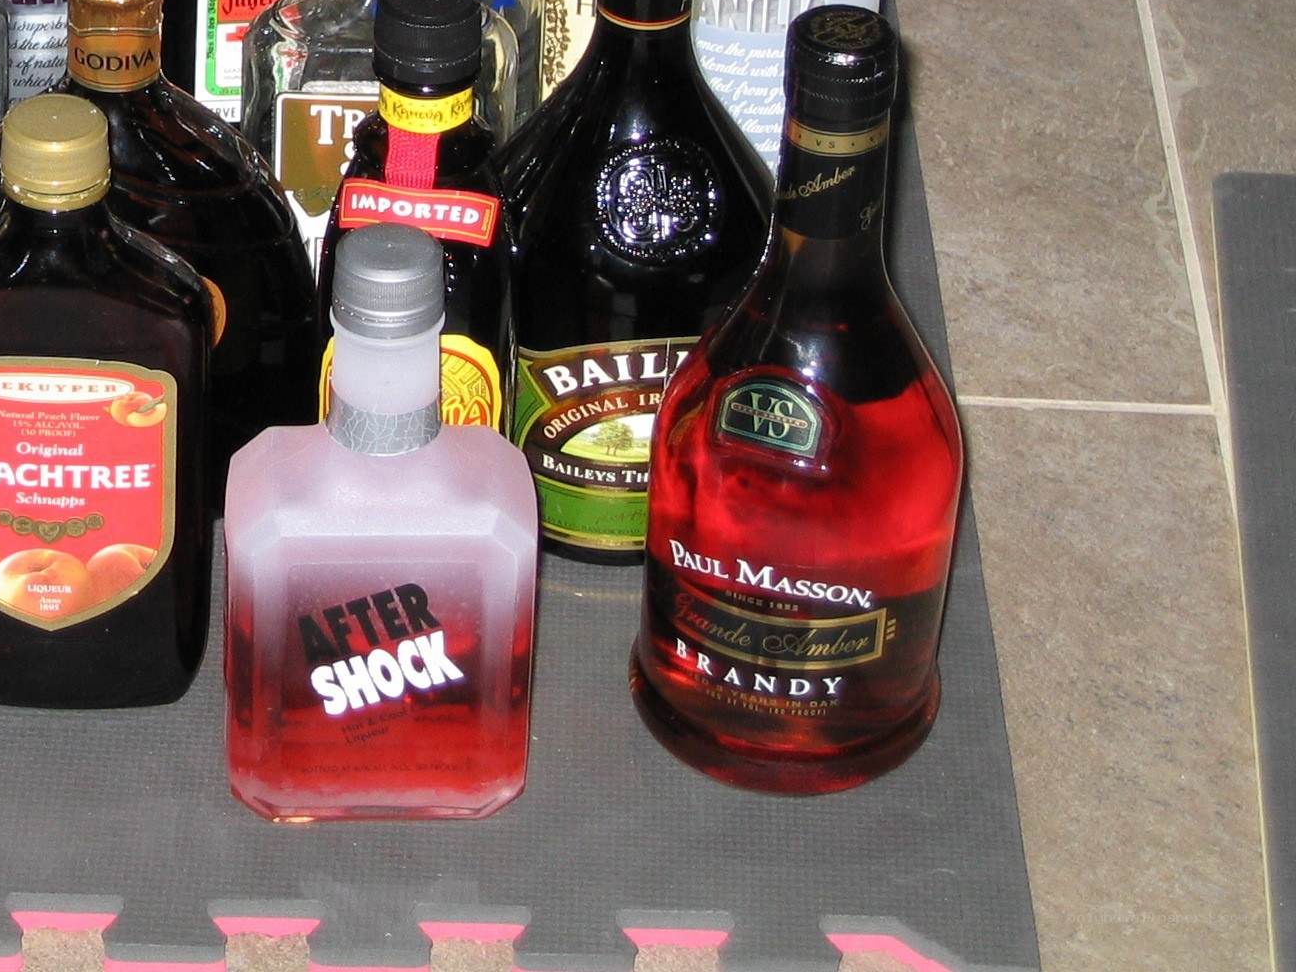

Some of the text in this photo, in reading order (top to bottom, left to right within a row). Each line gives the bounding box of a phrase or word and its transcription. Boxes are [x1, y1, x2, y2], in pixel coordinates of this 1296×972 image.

[73, 47, 155, 73] GODIVA
[746, 47, 785, 63] pures
[798, 164, 856, 197] Amber
[351, 193, 480, 225] IMPORTED
[542, 351, 669, 397] BAIL
[37, 411, 67, 421] Peach
[543, 393, 629, 439] ORIGINAL
[16, 441, 83, 458] Original
[542, 453, 649, 484] BAILEYS TH
[15, 491, 86, 509] Schnapps
[669, 538, 729, 579] PAUL
[27, 584, 73, 594] LIQUEUR
[297, 583, 442, 665] AFTER
[762, 627, 870, 659] Amber
[310, 630, 464, 716] SHOCK
[675, 637, 842, 696] BRANDY
